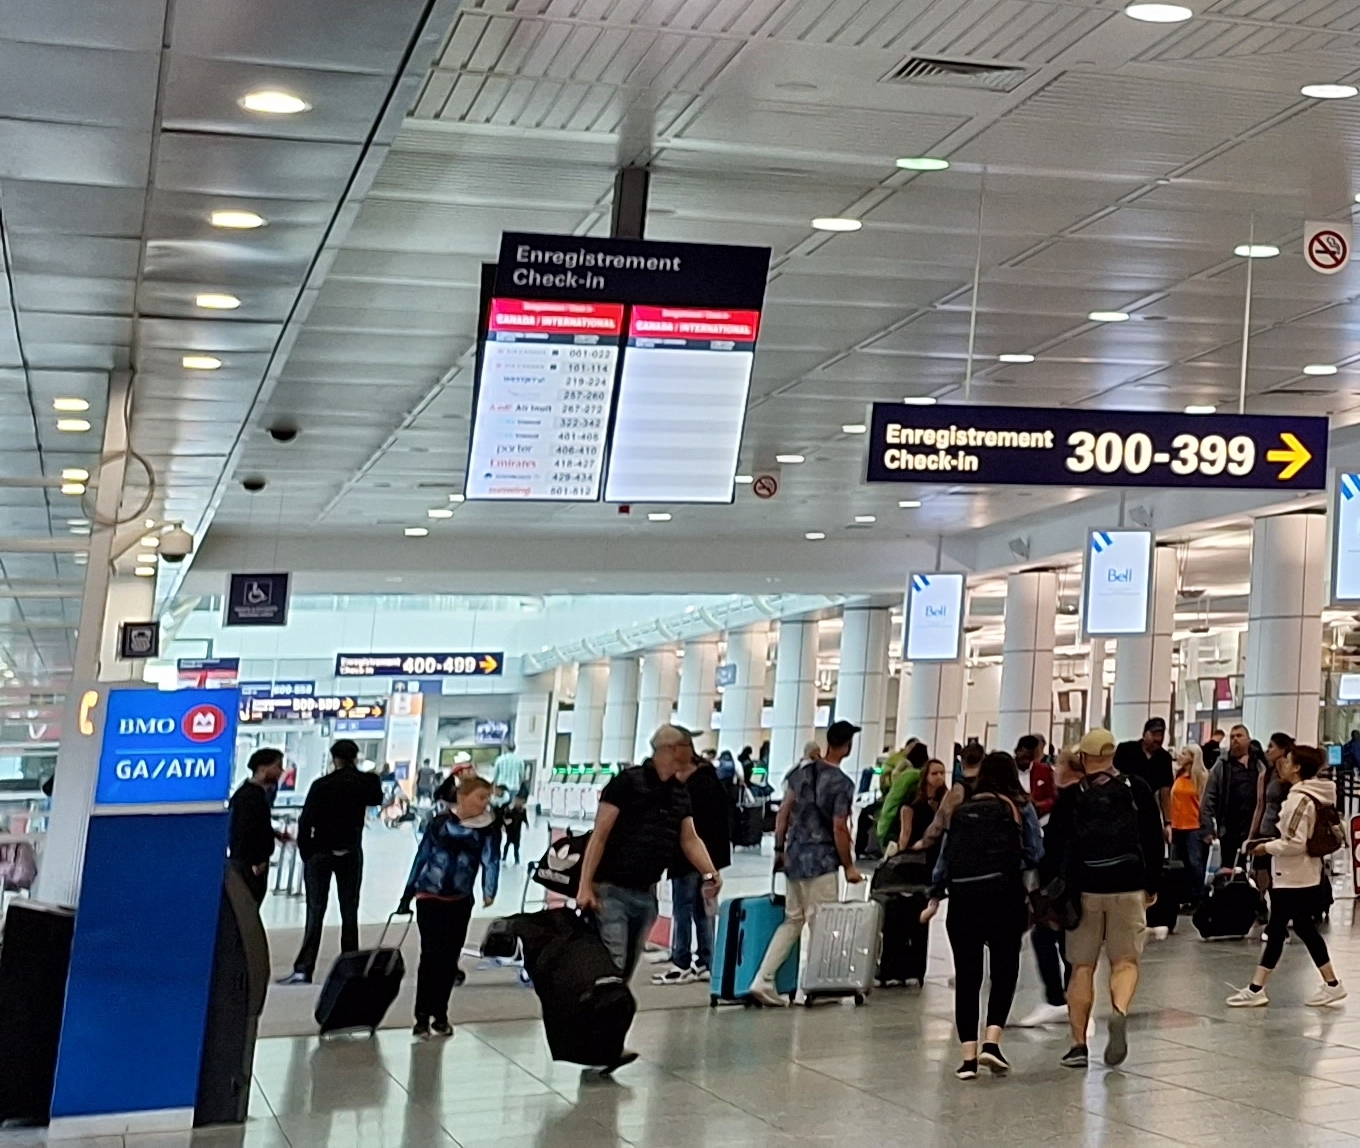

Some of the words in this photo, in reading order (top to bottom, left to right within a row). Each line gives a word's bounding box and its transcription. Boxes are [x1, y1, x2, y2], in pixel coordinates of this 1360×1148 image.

[516, 244, 682, 272] Enregistrement
[512, 268, 606, 290] Check-in
[496, 313, 536, 326] CANADA
[541, 315, 616, 330] INTERNATIONAL
[885, 423, 1055, 450] Enregistrement
[883, 449, 979, 472] Check-in
[1065, 430, 1256, 476] 300-399
[1107, 568, 1133, 583] Bell
[924, 606, 947, 618] Bell
[119, 718, 176, 735] BMO
[115, 757, 216, 780] GA/ATM
